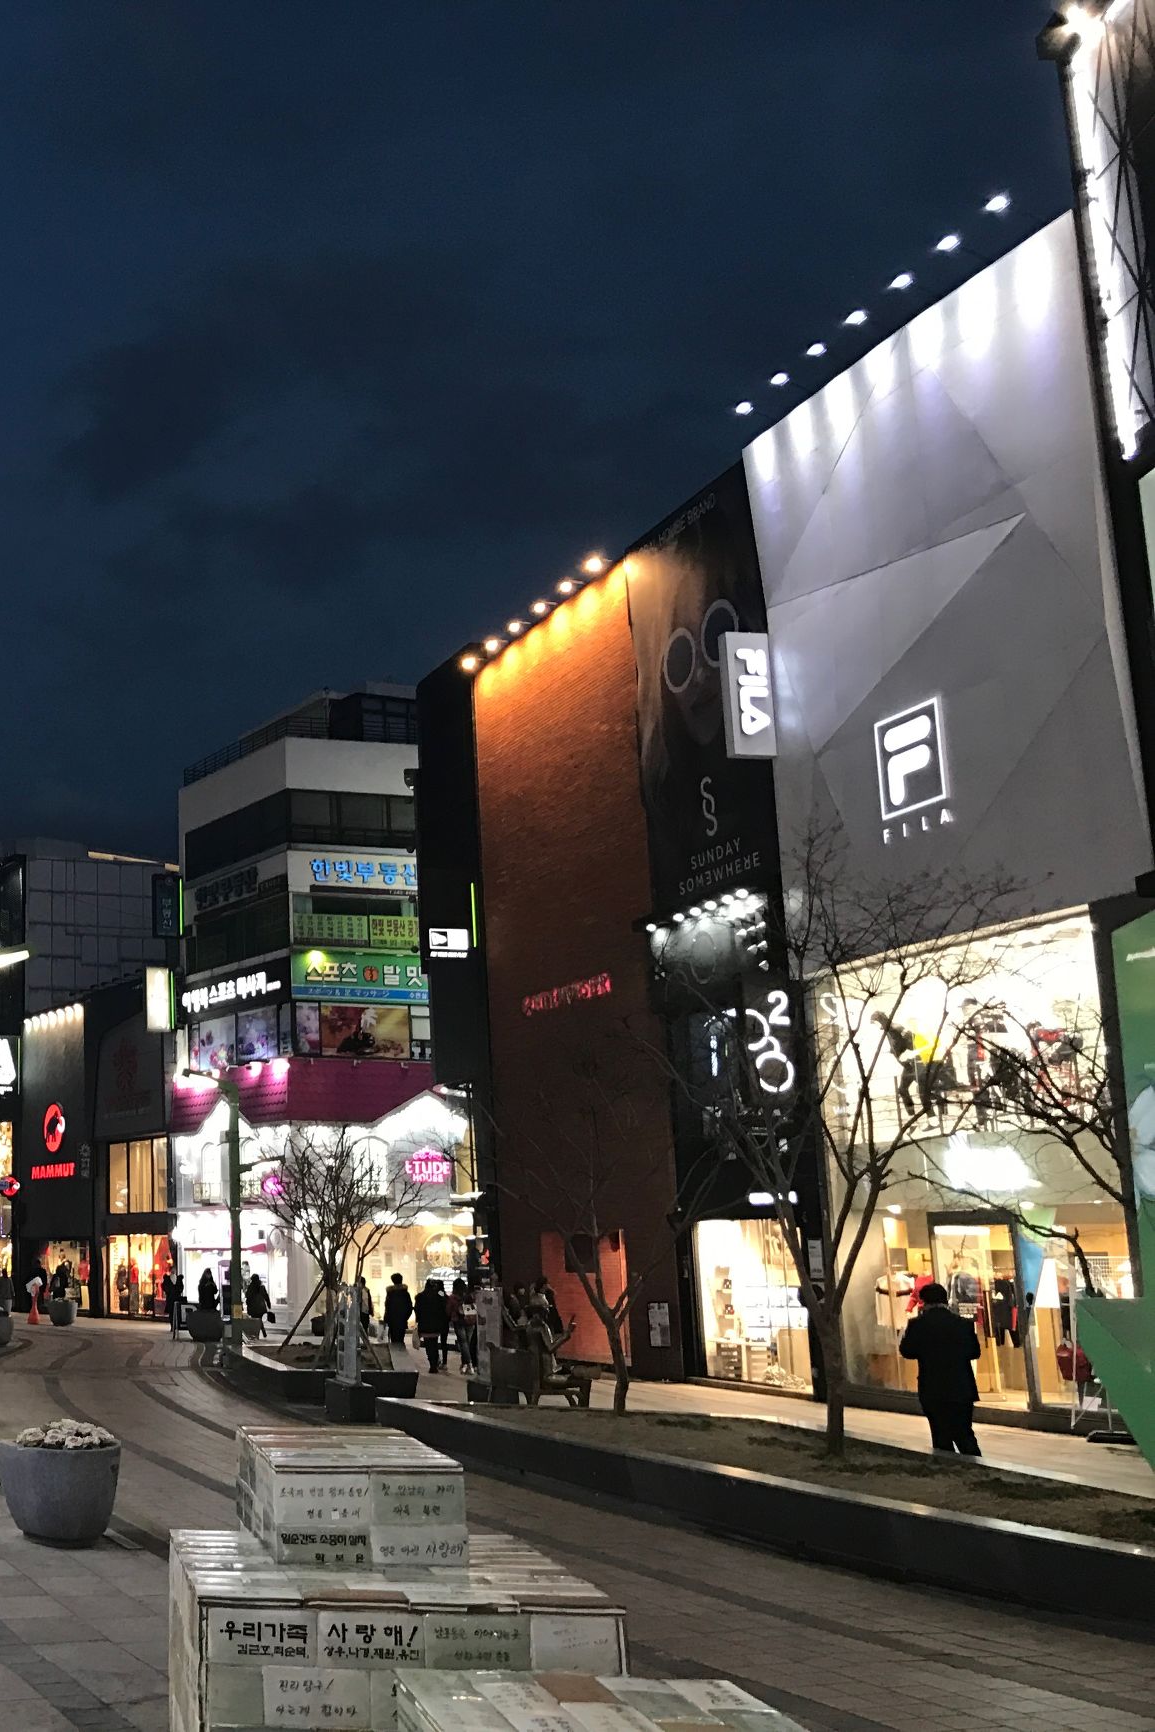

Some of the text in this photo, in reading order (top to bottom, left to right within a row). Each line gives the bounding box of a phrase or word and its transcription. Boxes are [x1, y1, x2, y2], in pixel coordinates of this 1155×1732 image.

[735, 647, 771, 736] FILA
[882, 808, 953, 845] FILA
[690, 837, 741, 870] SUNDAY
[678, 852, 761, 896] SOMEWHERE
[306, 961, 357, 982] 스포츠
[383, 964, 401, 986] 발
[31, 1162, 76, 1180] MAMMUT
[412, 1173, 444, 1183] HOUSE
